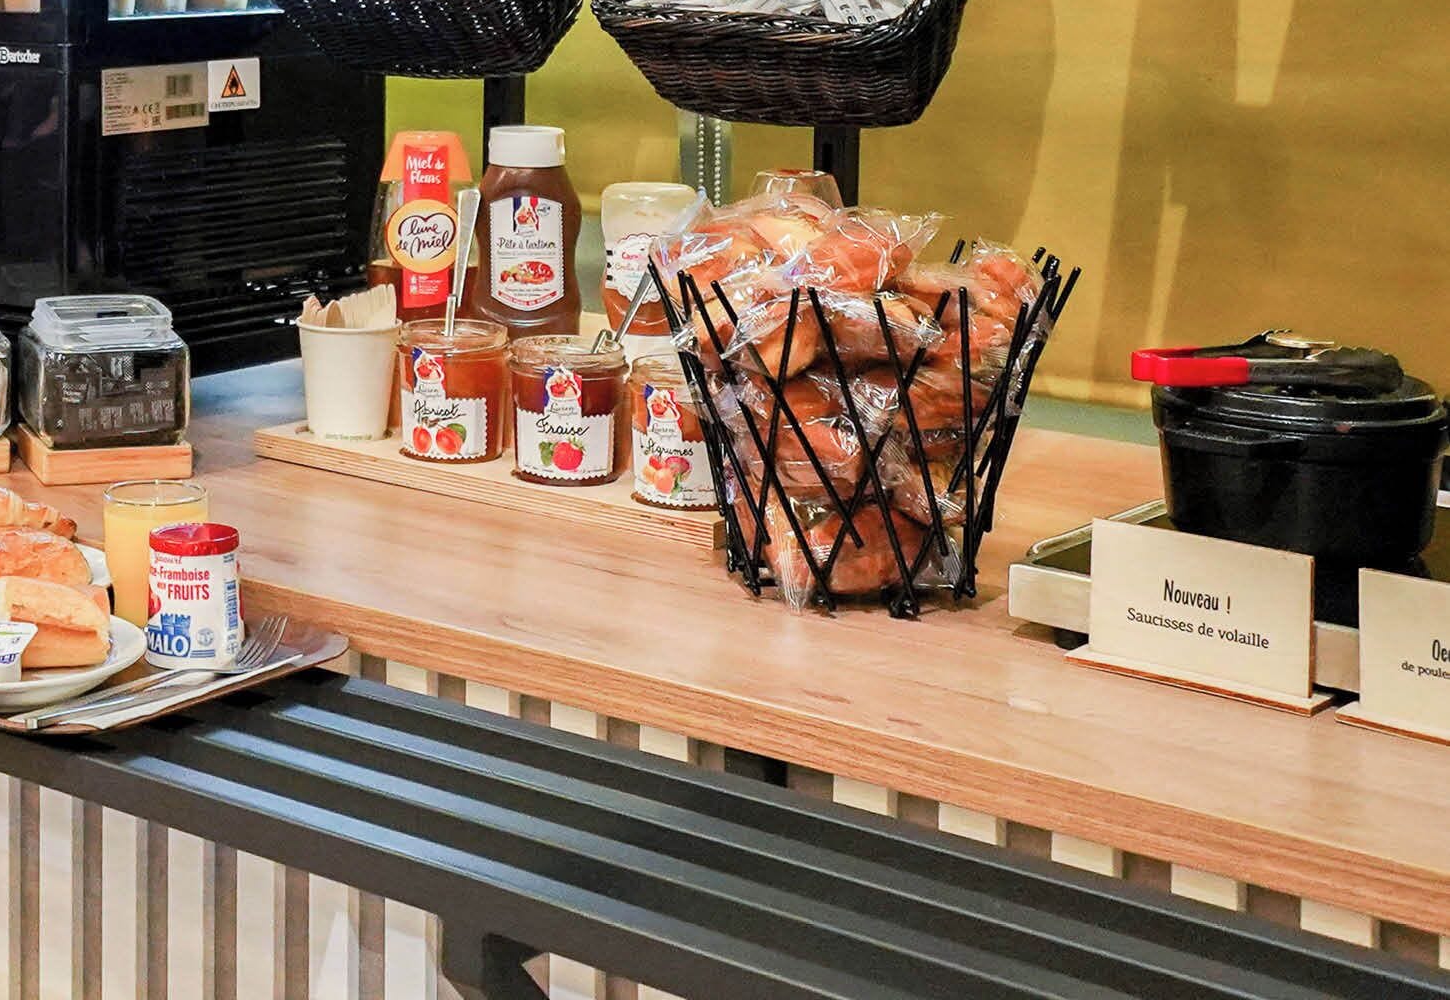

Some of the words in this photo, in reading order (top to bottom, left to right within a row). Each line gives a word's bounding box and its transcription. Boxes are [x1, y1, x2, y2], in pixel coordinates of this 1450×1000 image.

[406, 151, 432, 171] Miel
[435, 159, 446, 170] de
[407, 219, 442, 236] lune
[395, 239, 408, 251] de
[411, 231, 449, 258] miel
[496, 237, 517, 249] Pâte
[518, 238, 524, 249] à
[525, 238, 557, 249] tartiner
[414, 400, 462, 424] Abricot
[536, 415, 589, 436] Fraise
[644, 438, 694, 457] Agrumes
[168, 583, 210, 600] FRUITS
[1164, 578, 1219, 611] Nouveau
[1226, 596, 1231, 614] !
[1126, 607, 1194, 634] Saucisses
[1198, 623, 1214, 638] de
[1218, 629, 1270, 649] volaille
[1401, 660, 1415, 672] de
